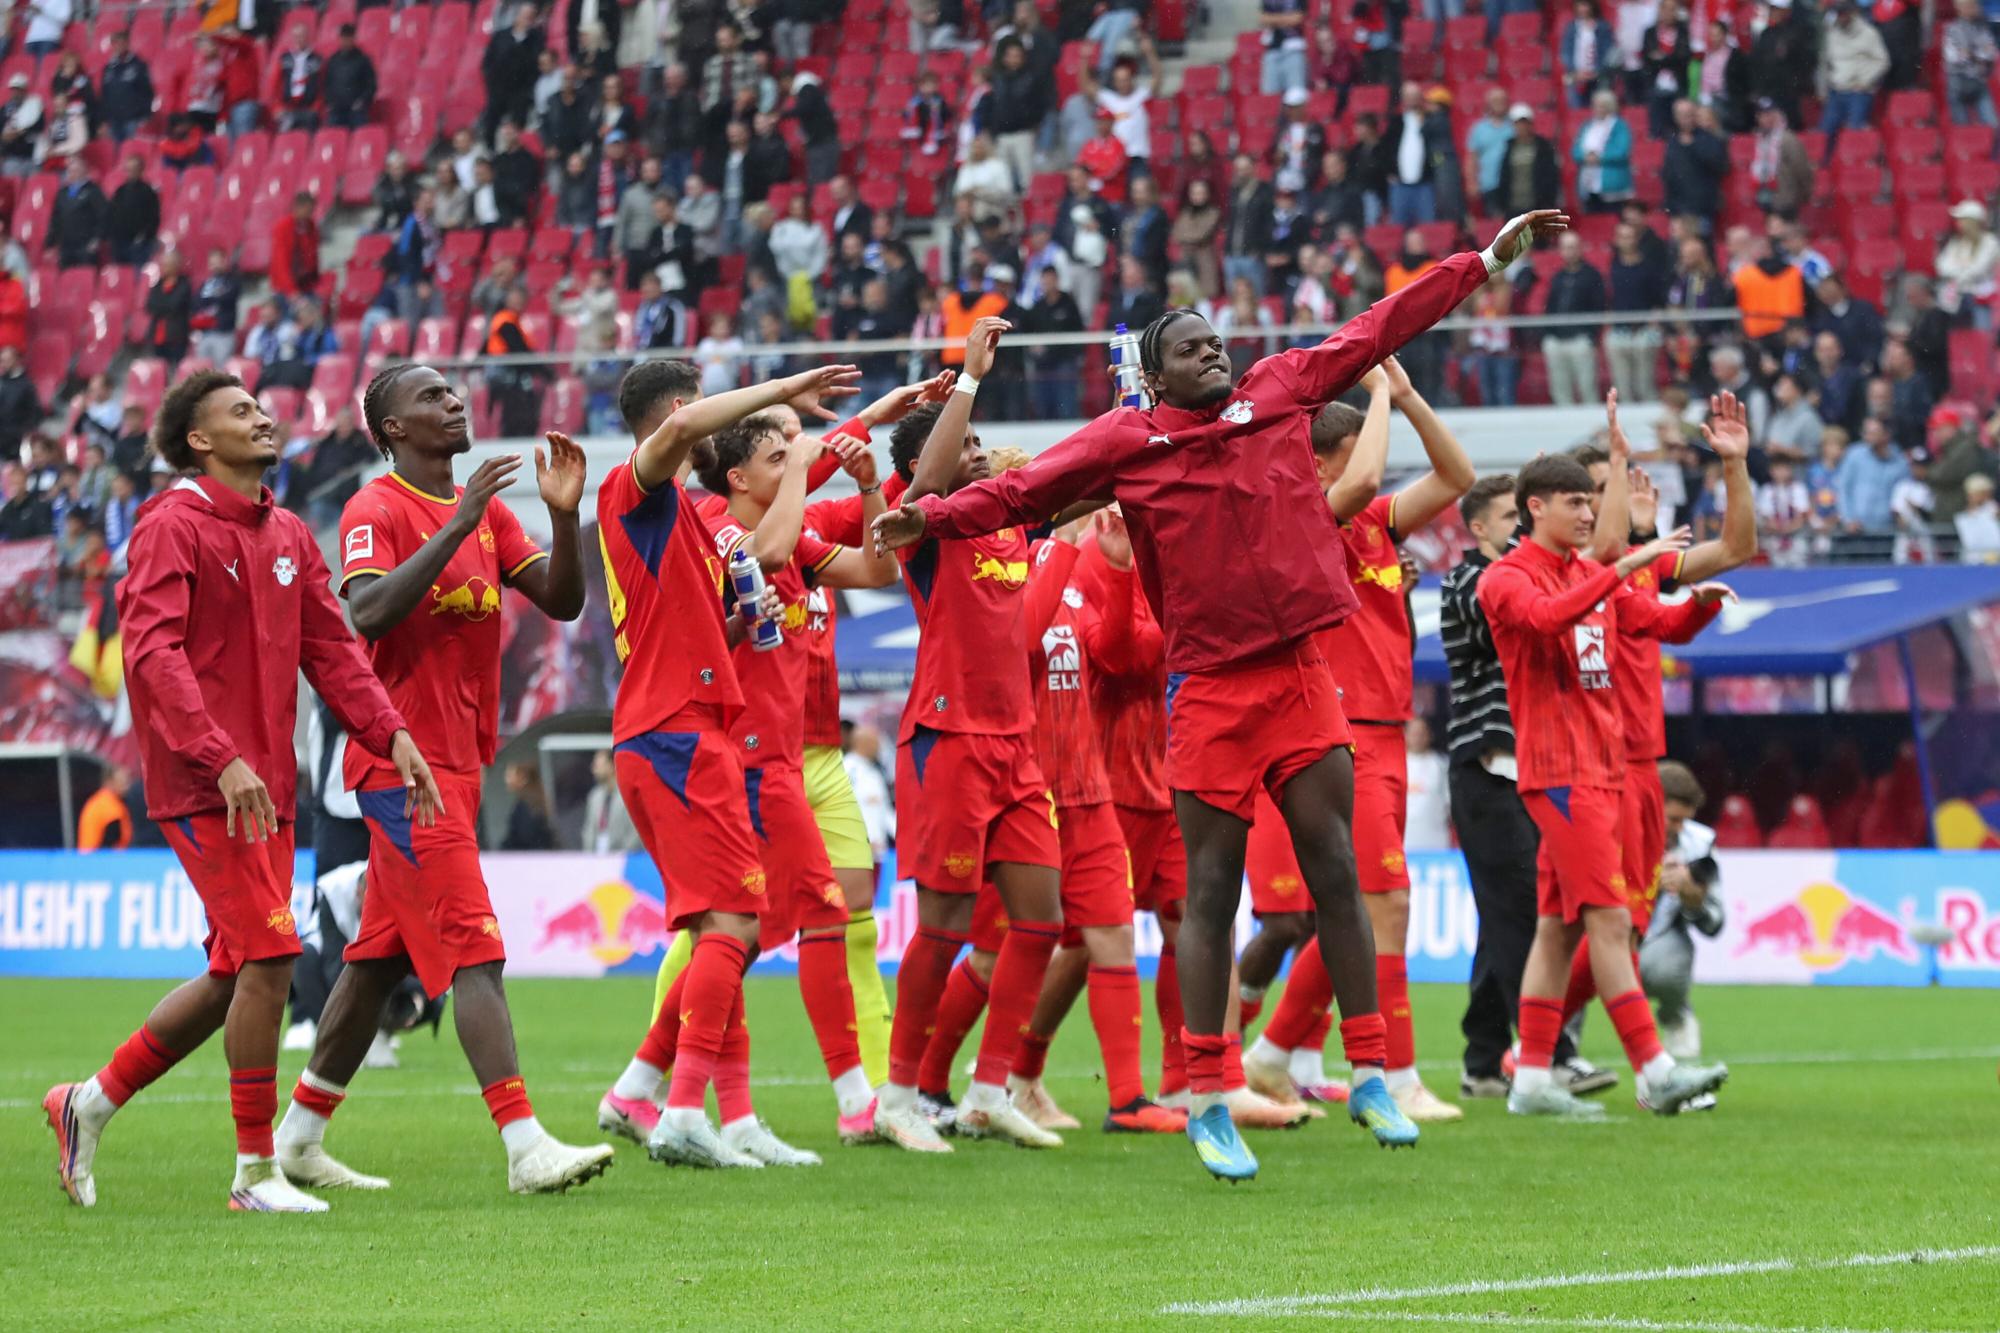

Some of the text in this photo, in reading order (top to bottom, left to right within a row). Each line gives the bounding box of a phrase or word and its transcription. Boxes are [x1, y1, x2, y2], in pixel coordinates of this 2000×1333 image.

[1048, 673, 1080, 691] ELK
[1579, 672, 1612, 689] ELK
[0, 880, 111, 949] LEIHT
